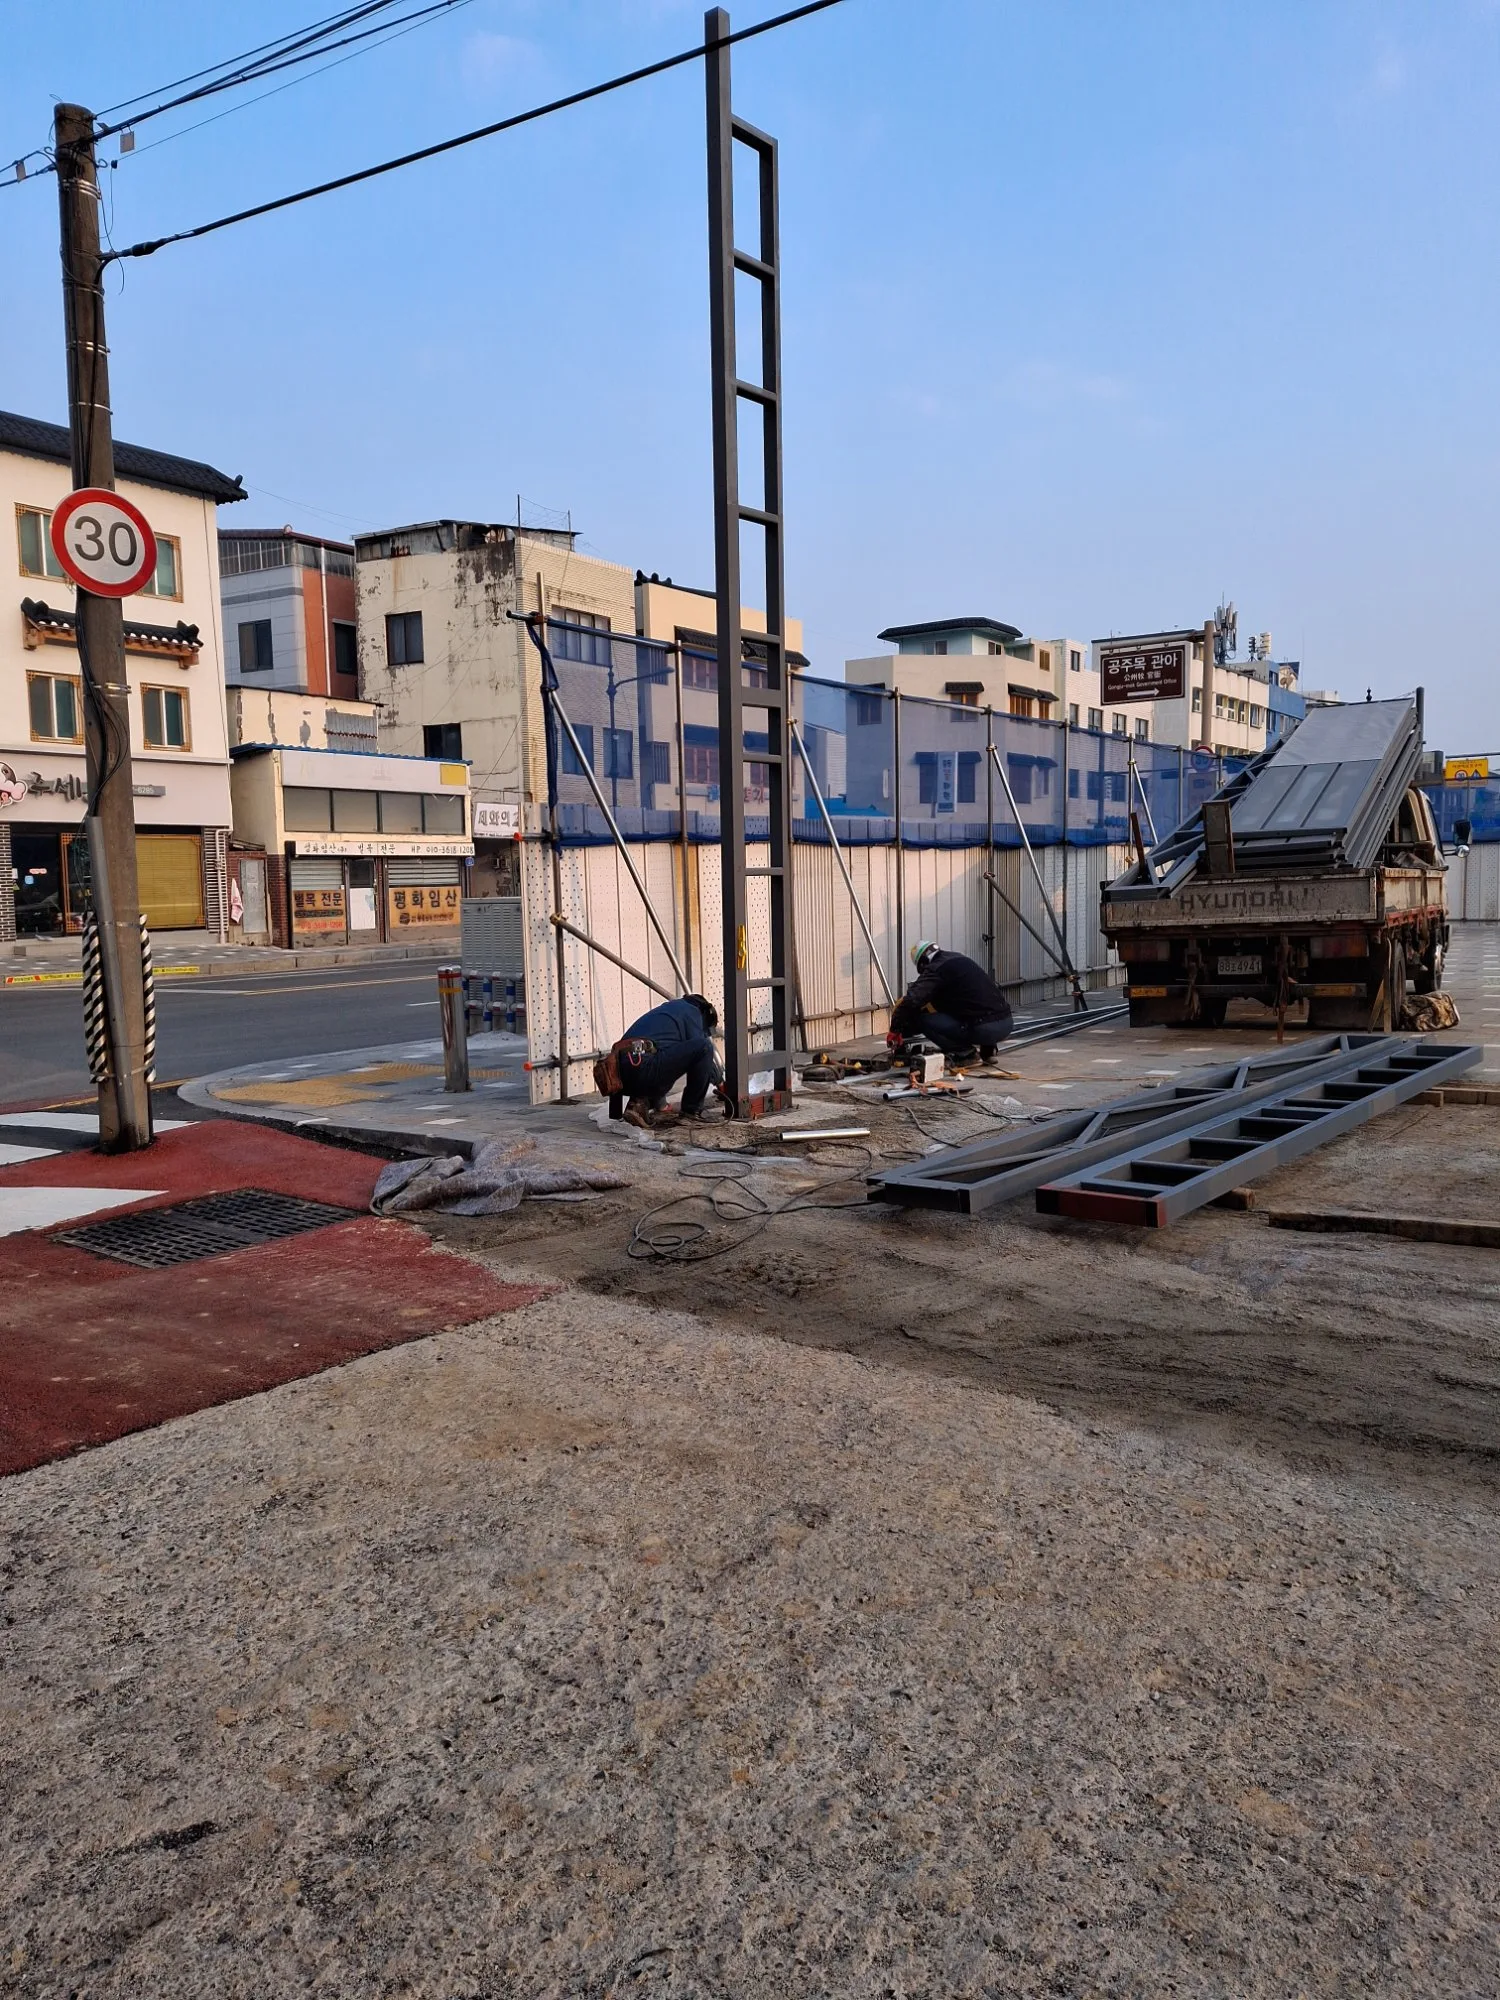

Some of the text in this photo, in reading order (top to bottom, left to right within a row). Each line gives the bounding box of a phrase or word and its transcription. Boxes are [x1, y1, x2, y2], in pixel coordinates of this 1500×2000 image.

[74, 515, 138, 567] 30
[1107, 652, 1178, 675] 공주목 관아
[1136, 679, 1163, 688] Government
[380, 843, 396, 855] 전문
[294, 892, 343, 908] 벌목 전문
[394, 889, 458, 910] 평화임산
[1180, 889, 1293, 910] HYUNDAI
